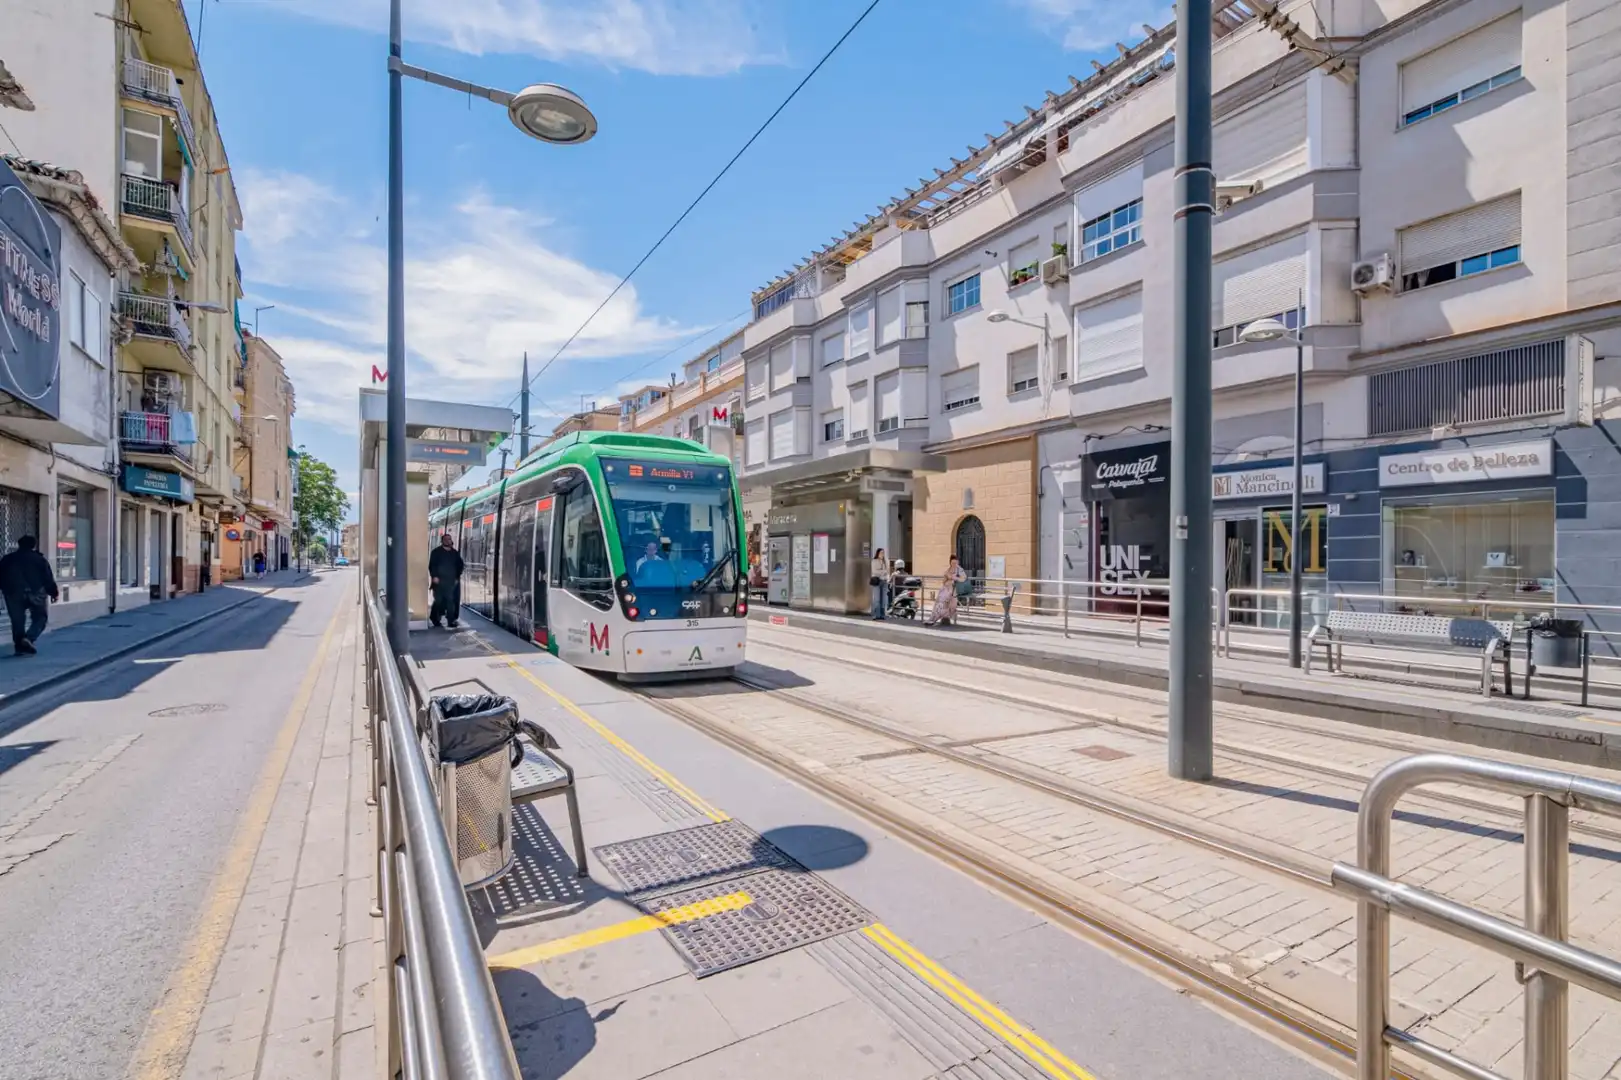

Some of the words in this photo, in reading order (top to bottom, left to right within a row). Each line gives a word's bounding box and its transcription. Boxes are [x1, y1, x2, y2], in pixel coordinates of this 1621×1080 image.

[7, 283, 50, 342] World
[713, 406, 728, 422] M
[1096, 455, 1158, 479] Carvajal
[1388, 461, 1445, 475] Centro
[1447, 457, 1470, 472] de
[1473, 451, 1540, 469] Belleza
[1236, 475, 1315, 494] Mancinli
[1100, 545, 1152, 570] UNI-
[1100, 570, 1151, 596] SEX
[686, 619, 699, 627] 315
[590, 622, 610, 656] M
